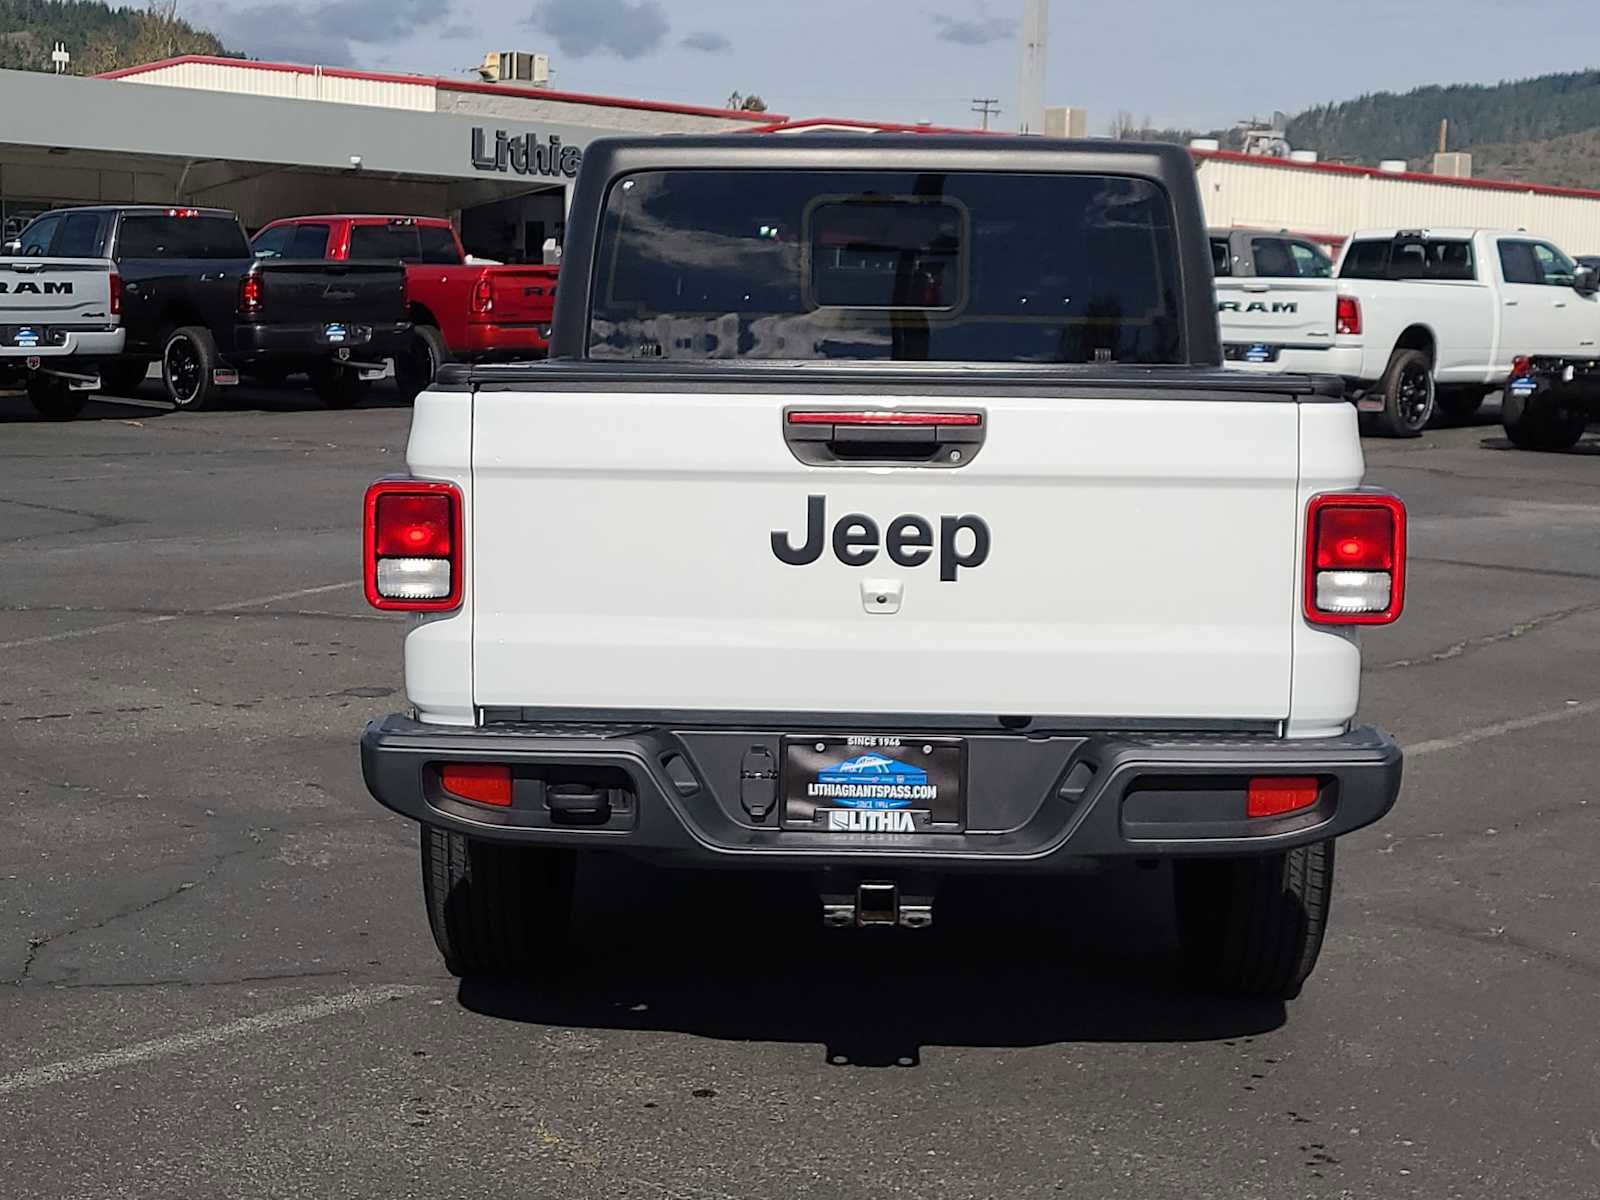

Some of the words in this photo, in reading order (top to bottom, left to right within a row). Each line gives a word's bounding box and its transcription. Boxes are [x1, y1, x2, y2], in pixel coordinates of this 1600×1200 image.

[471, 127, 581, 178] Lithia
[1219, 301, 1298, 313] RAM
[770, 494, 991, 582] Jeep
[847, 735, 877, 747] SINCE
[807, 783, 938, 800] LITHIAGRANTSPASS.COM
[849, 811, 916, 832] LITHIA
